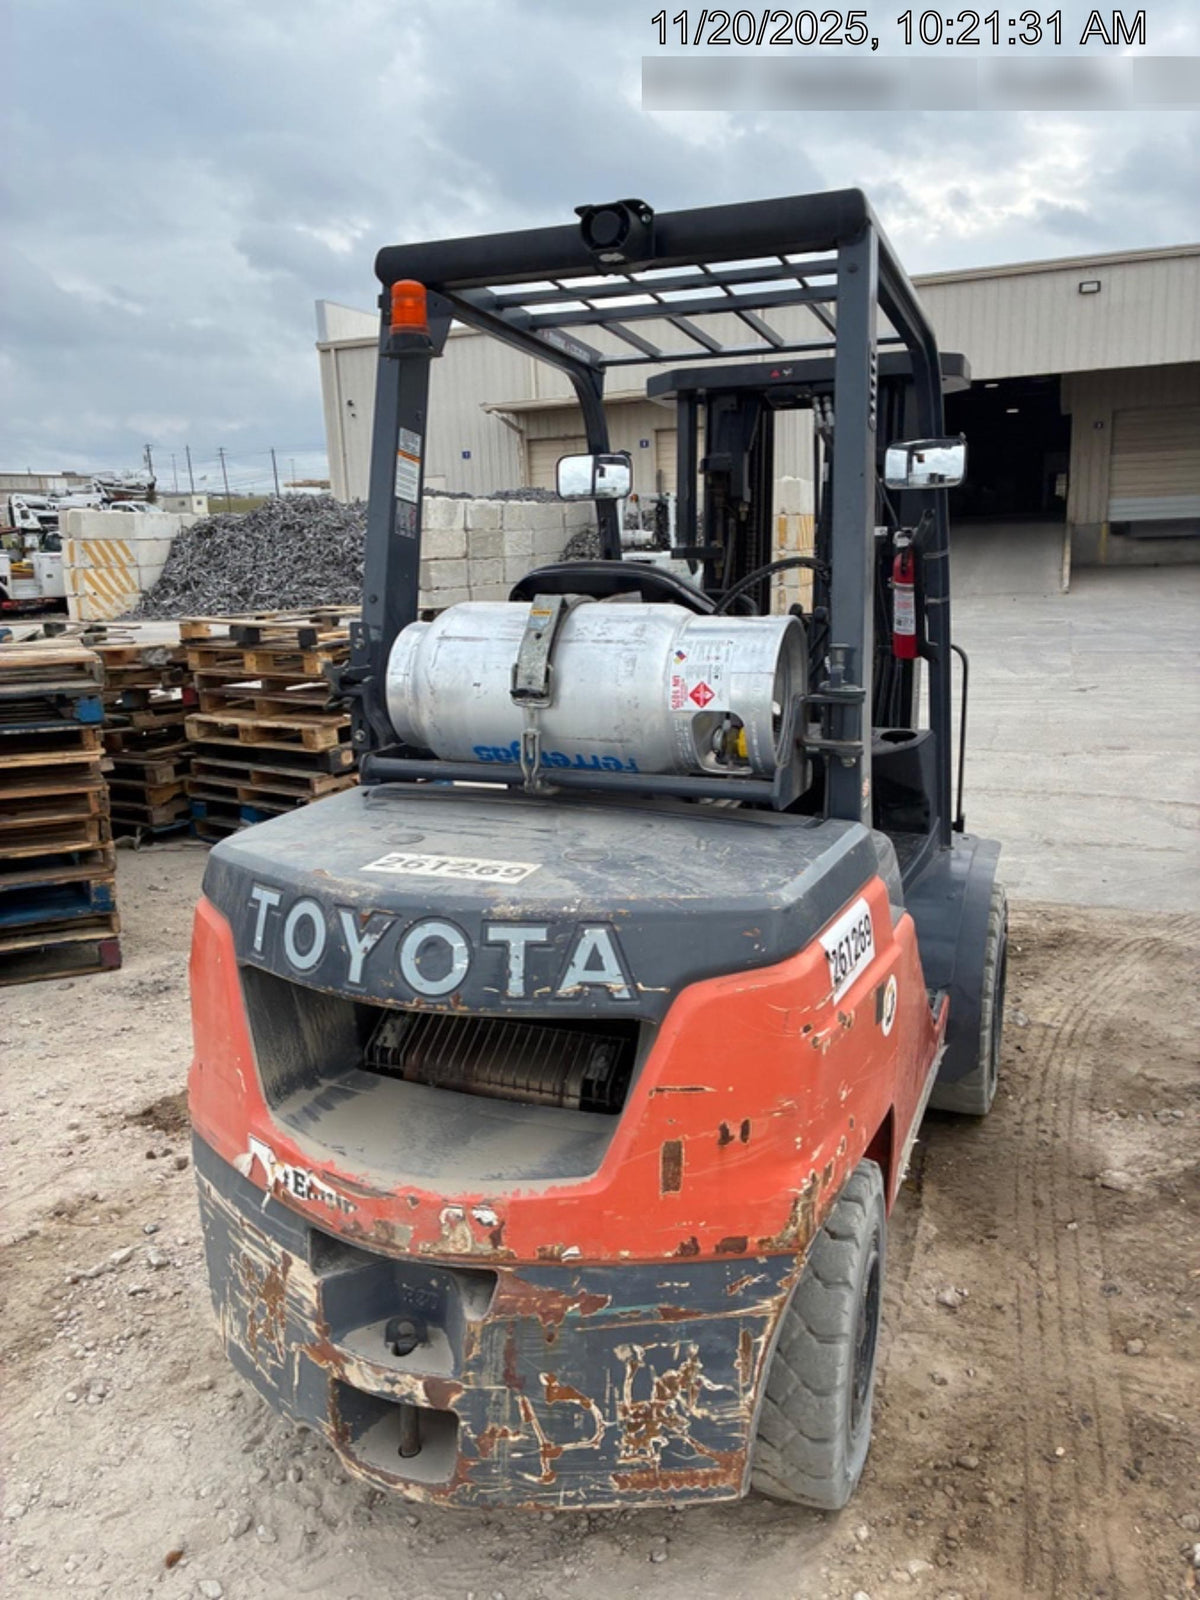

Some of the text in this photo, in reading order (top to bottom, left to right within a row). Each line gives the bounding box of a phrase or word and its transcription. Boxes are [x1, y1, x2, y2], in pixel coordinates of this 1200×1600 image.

[374, 855, 528, 878] 261269
[250, 884, 632, 1000] TOYOTA
[827, 913, 873, 984] 261269
